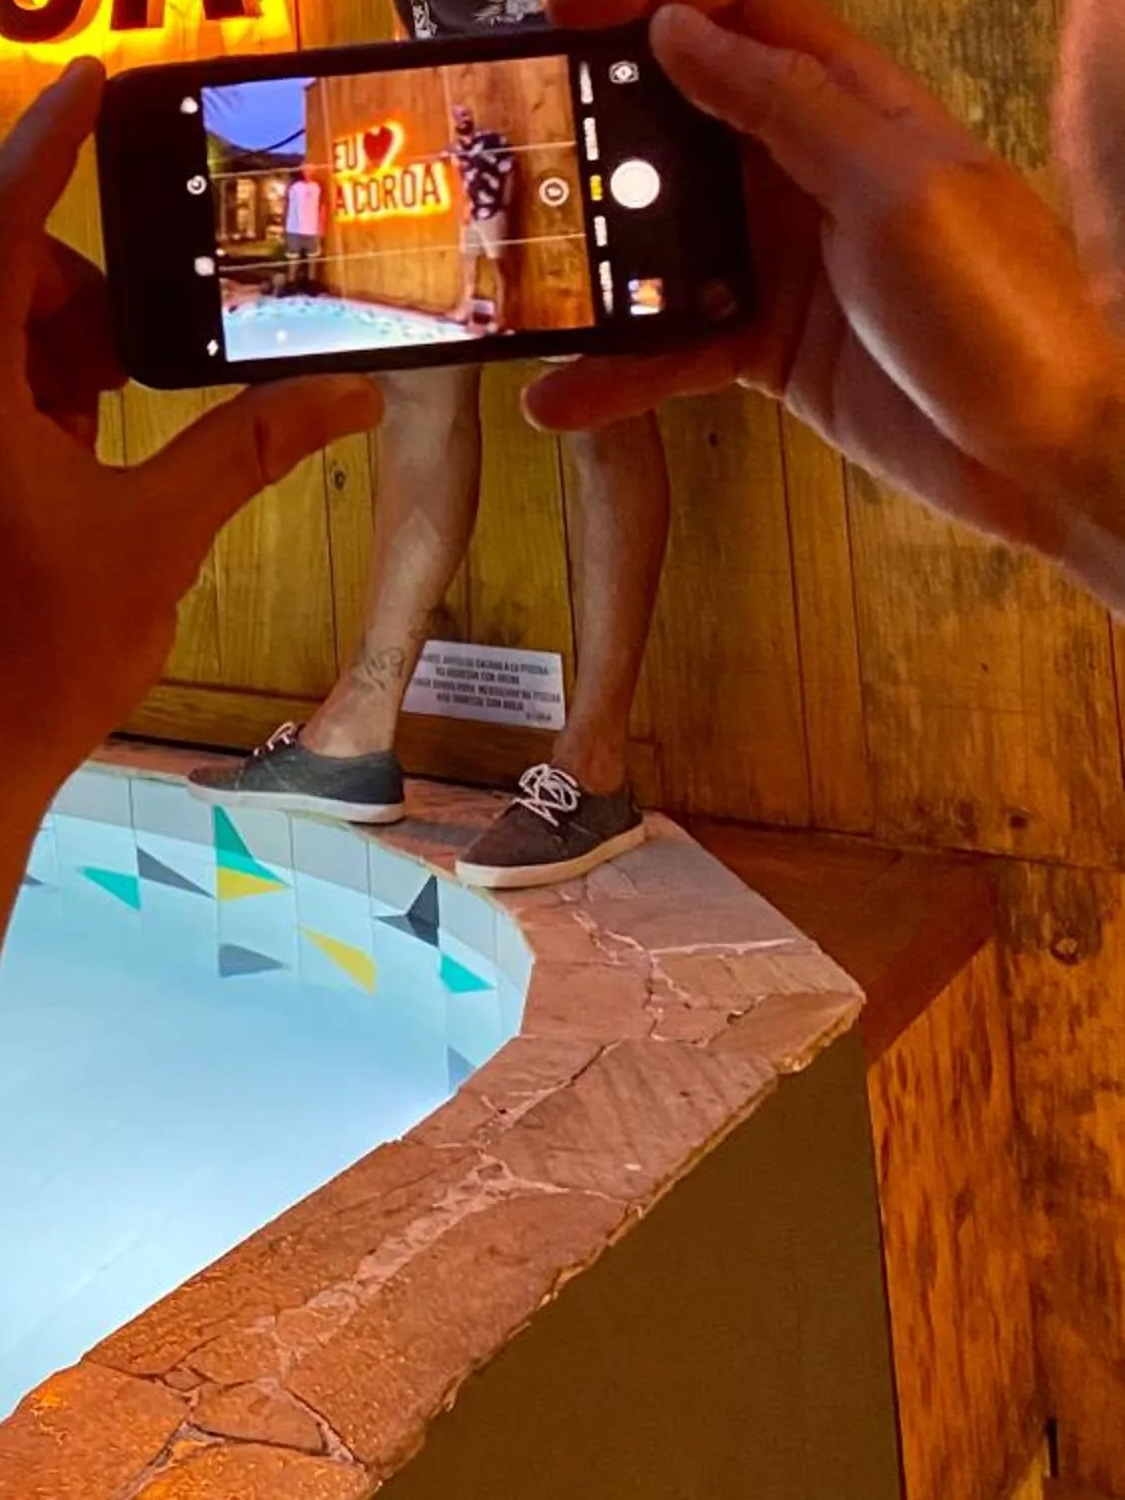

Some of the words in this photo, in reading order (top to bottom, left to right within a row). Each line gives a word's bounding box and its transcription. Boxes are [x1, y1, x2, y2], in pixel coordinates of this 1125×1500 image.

[333, 136, 358, 173] EU
[335, 184, 349, 216] A
[353, 163, 441, 215] COROA
